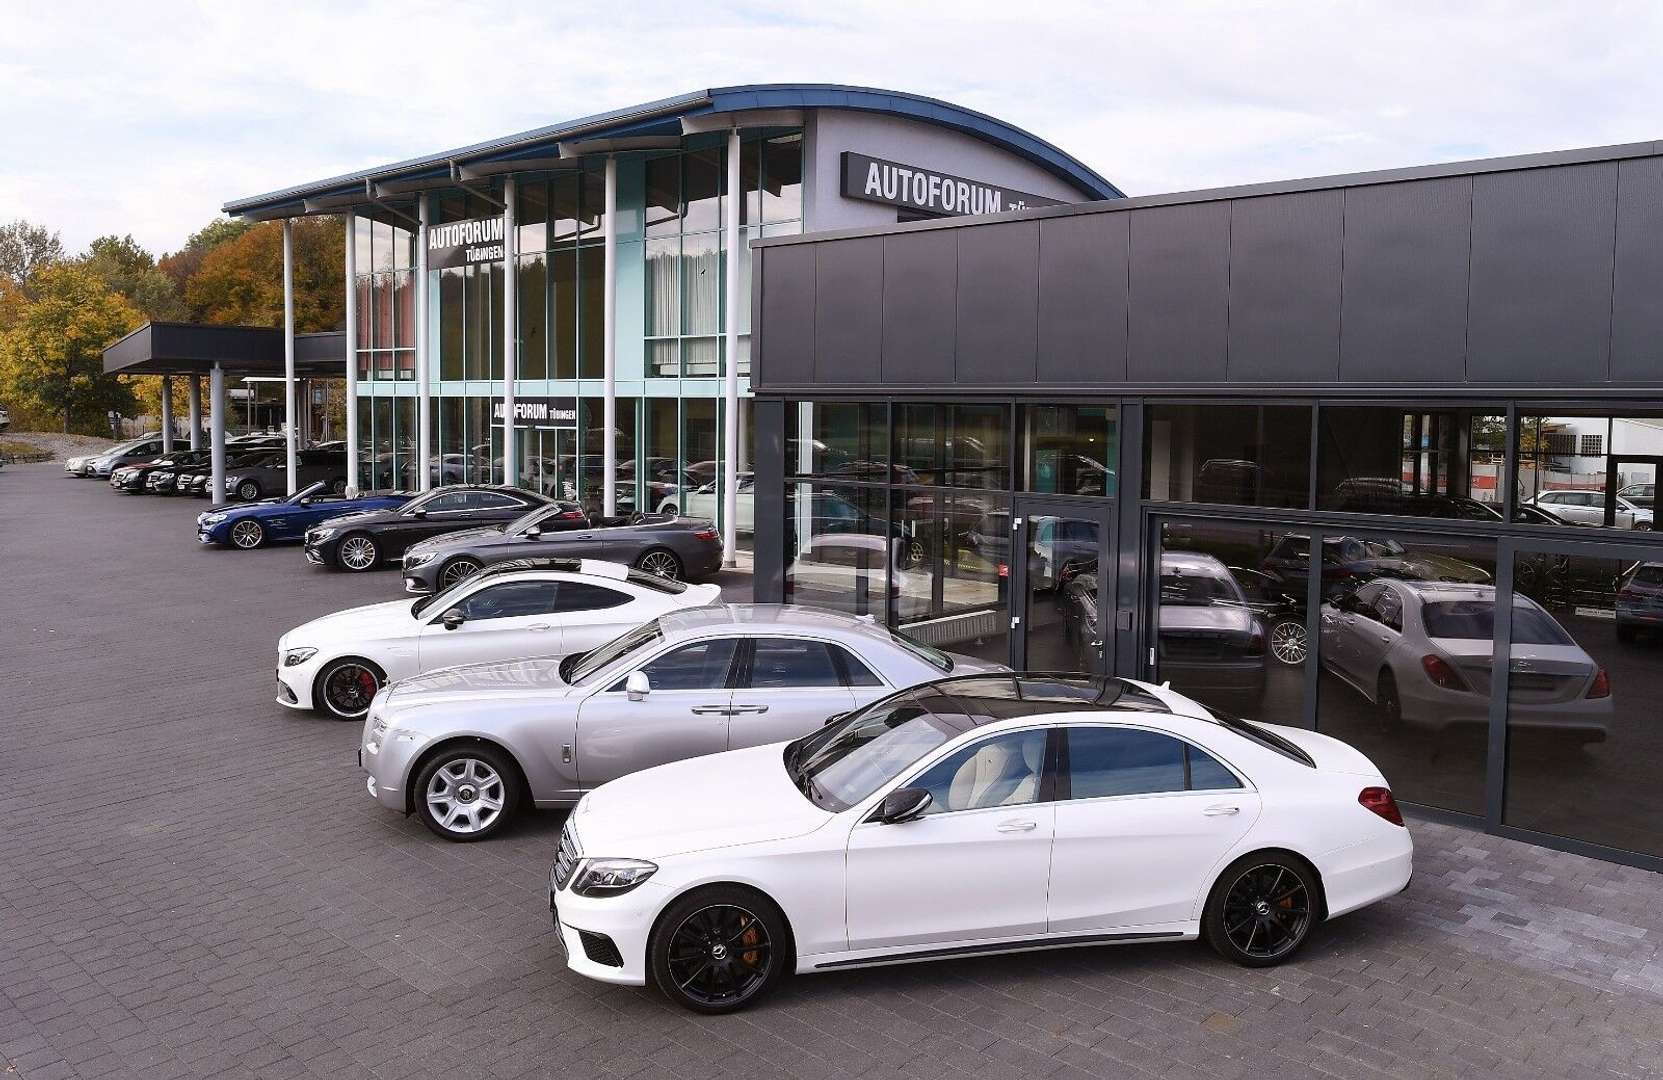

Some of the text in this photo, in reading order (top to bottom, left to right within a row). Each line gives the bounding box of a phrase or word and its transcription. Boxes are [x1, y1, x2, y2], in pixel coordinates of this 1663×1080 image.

[864, 162, 1001, 216] AUTOFORUM
[429, 217, 503, 250] AUTOFORUM
[465, 245, 503, 262] TÜBINGEN
[494, 403, 547, 419] AUFORUM
